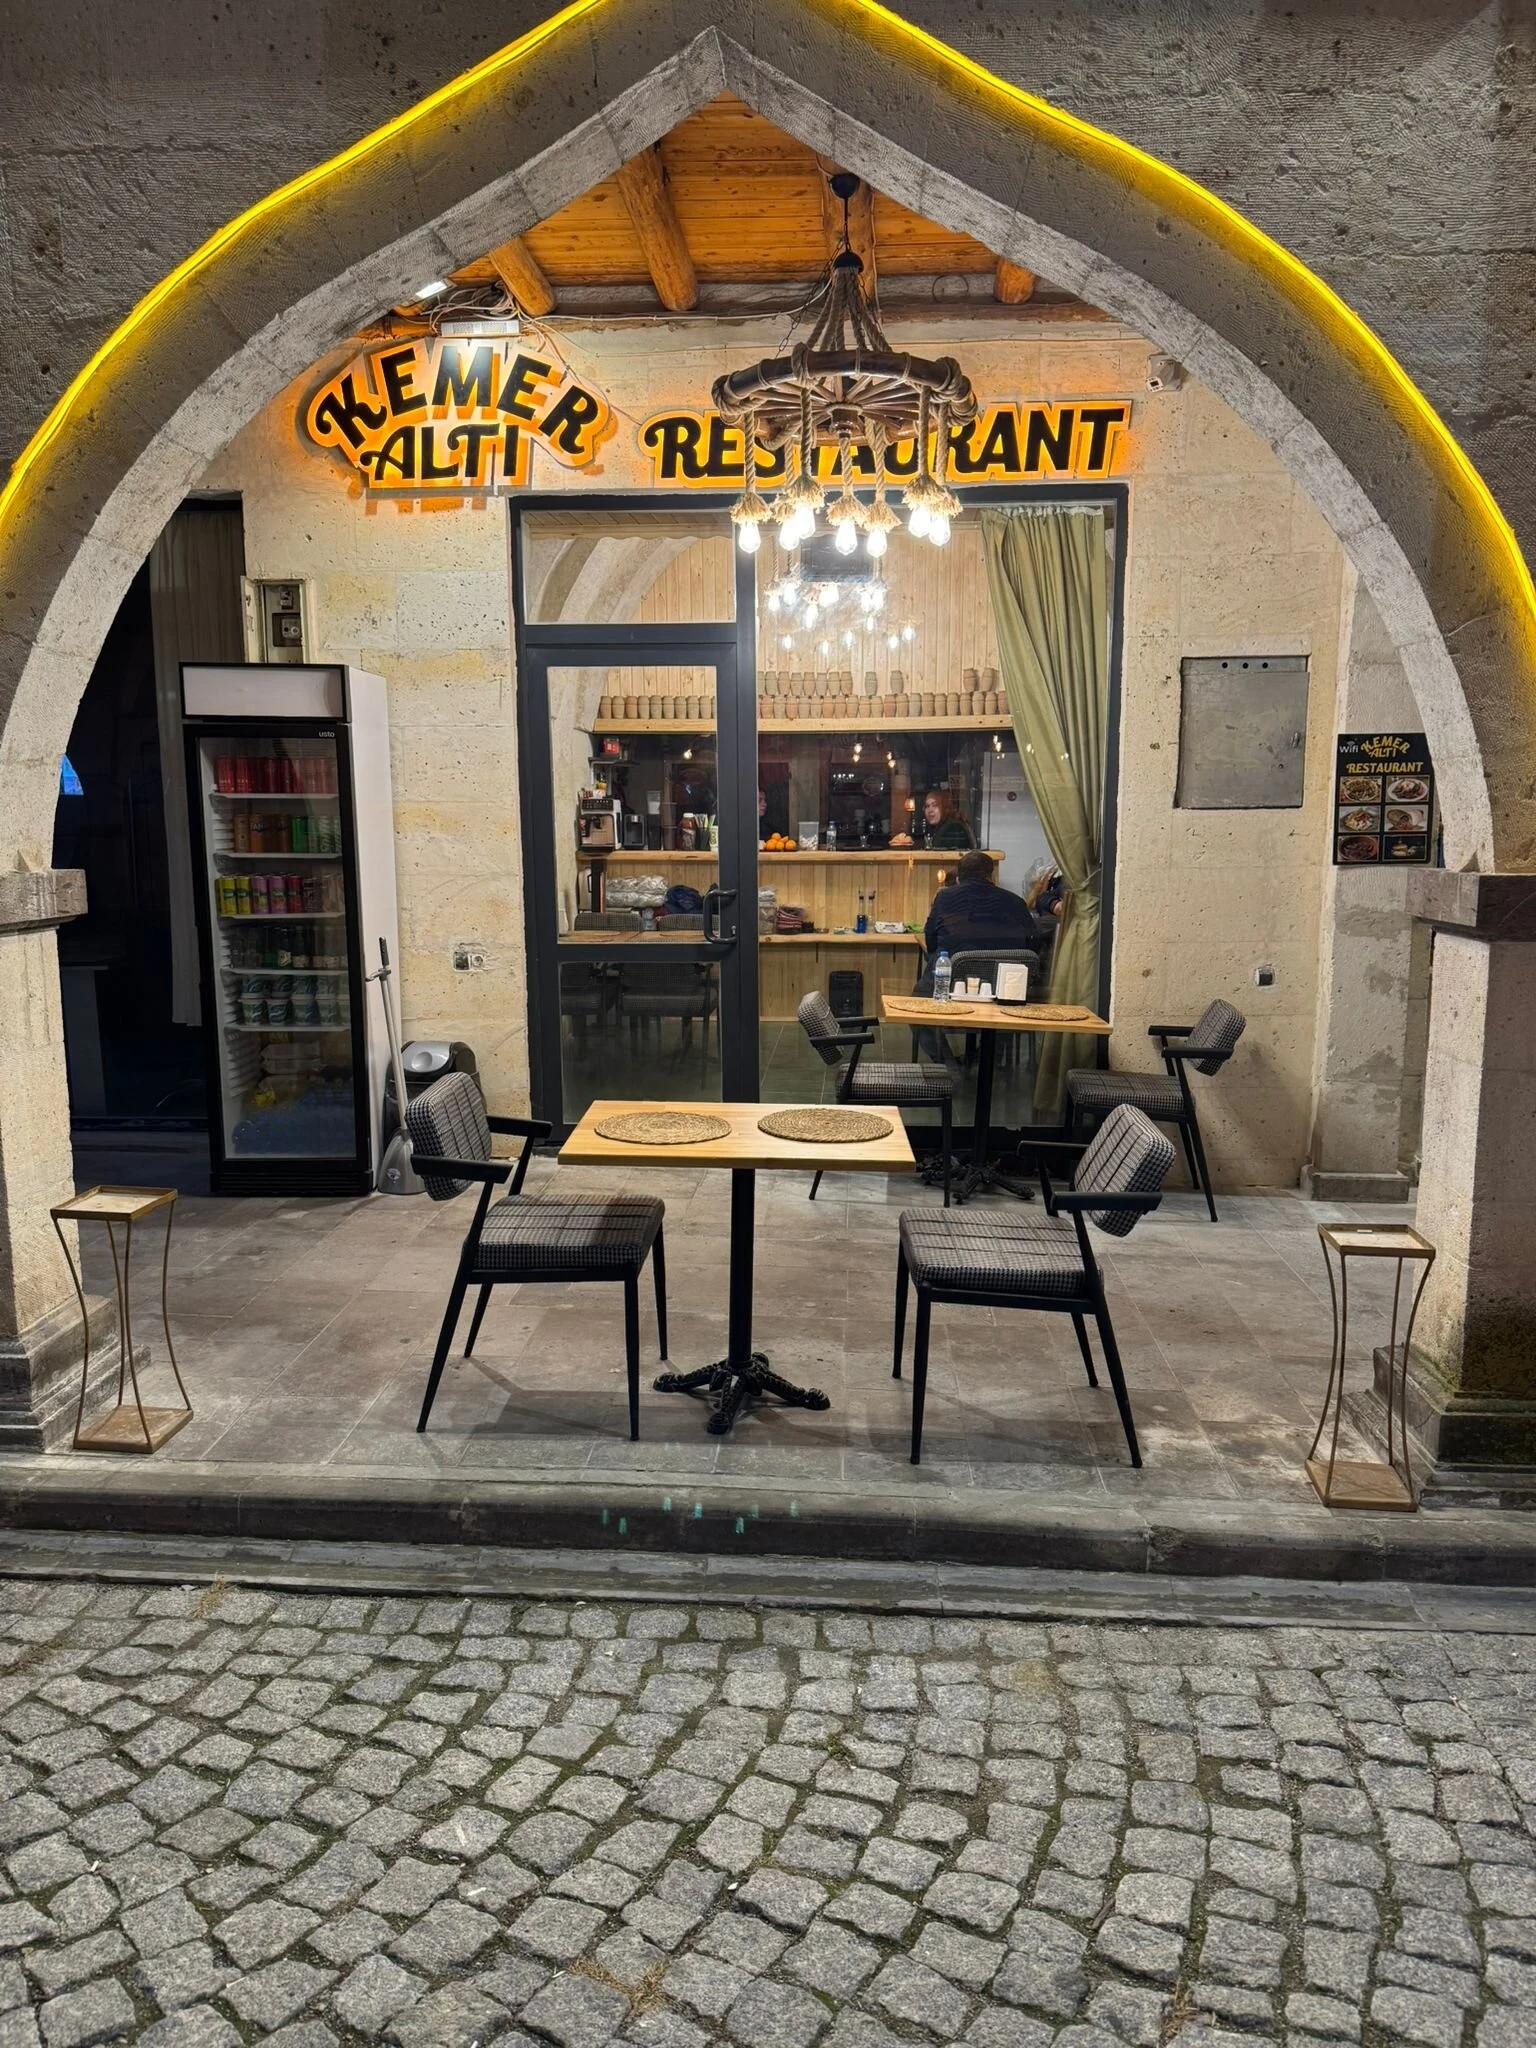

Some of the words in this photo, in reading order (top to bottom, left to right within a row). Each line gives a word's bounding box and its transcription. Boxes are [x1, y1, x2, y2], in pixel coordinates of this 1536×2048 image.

[315, 346, 599, 455] KEMER
[359, 423, 518, 481] ALTI
[644, 408, 1126, 478] RESURANT
[1360, 736, 1410, 753] KEMER
[1368, 748, 1396, 758] ALTI
[1346, 762, 1423, 773] RESTAURANT
